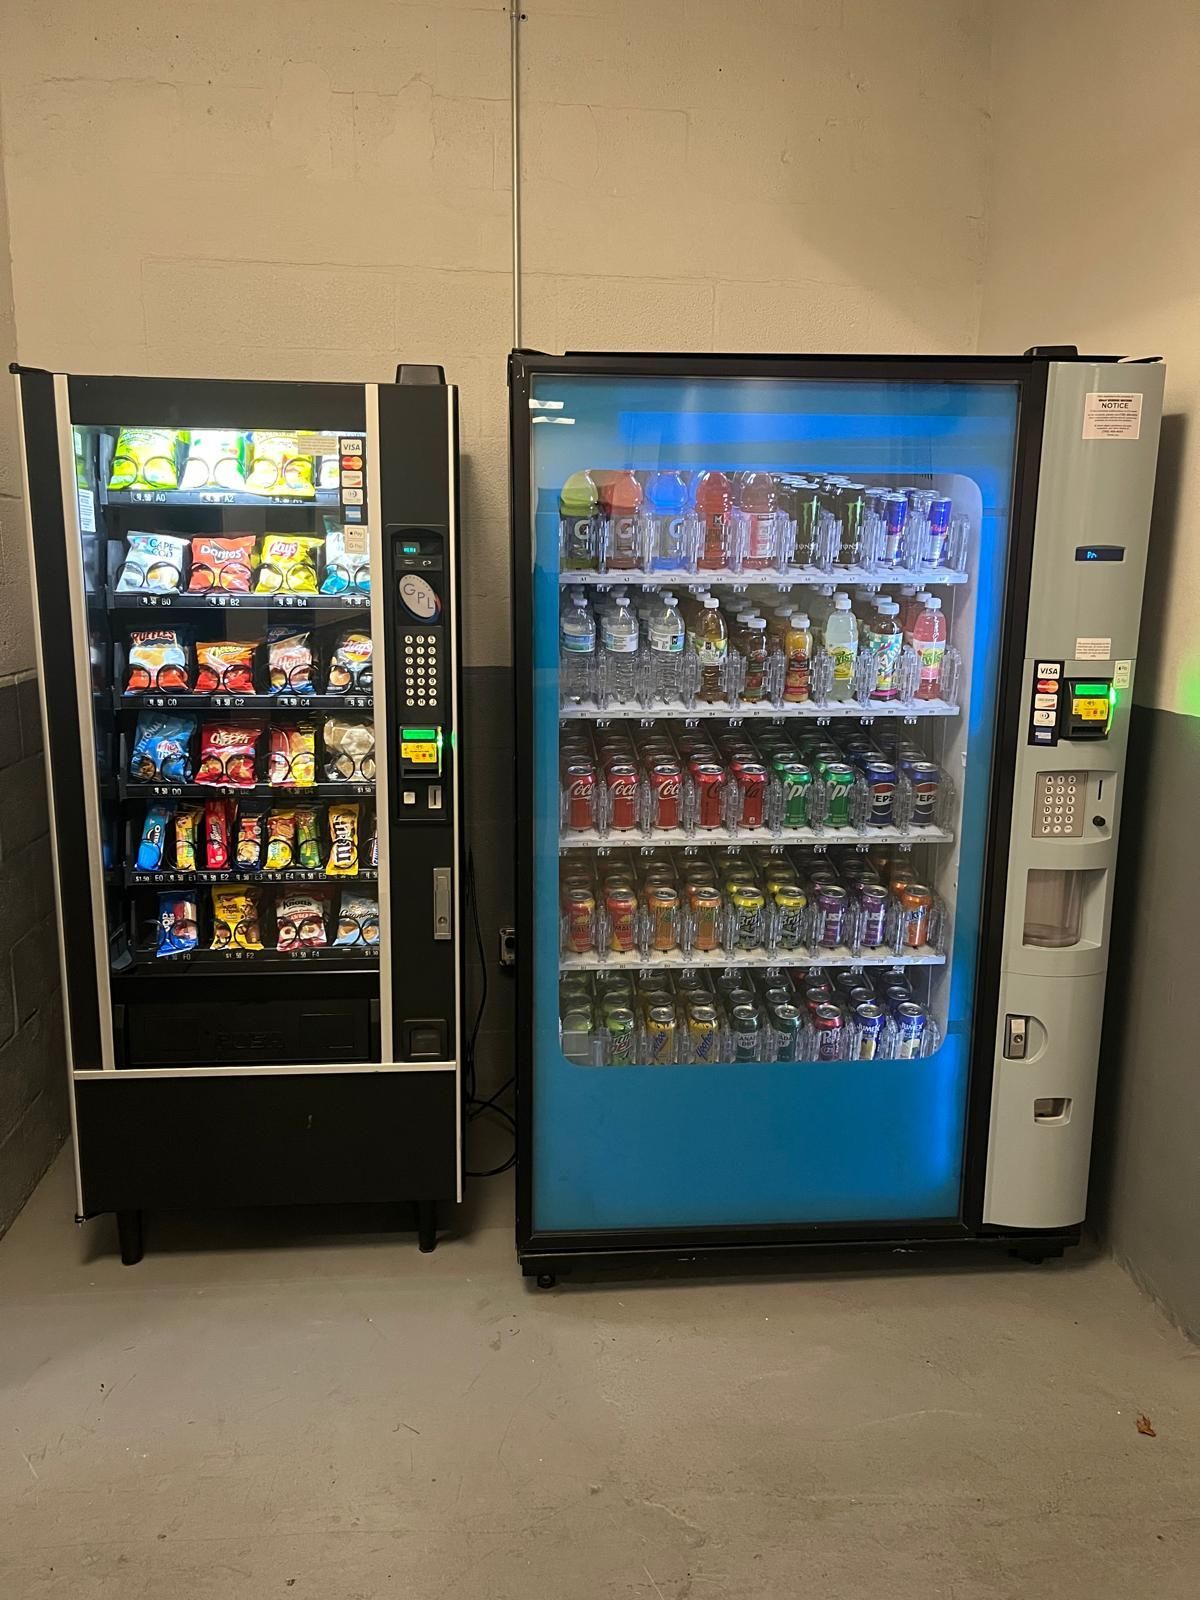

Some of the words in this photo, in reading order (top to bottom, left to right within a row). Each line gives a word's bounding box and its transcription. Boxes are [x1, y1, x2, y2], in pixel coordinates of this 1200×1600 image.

[156, 494, 166, 502] A0
[201, 544, 242, 560] Doritos
[270, 541, 298, 558] Lay's
[403, 583, 434, 610] GPL
[132, 631, 176, 644] RUFFLES
